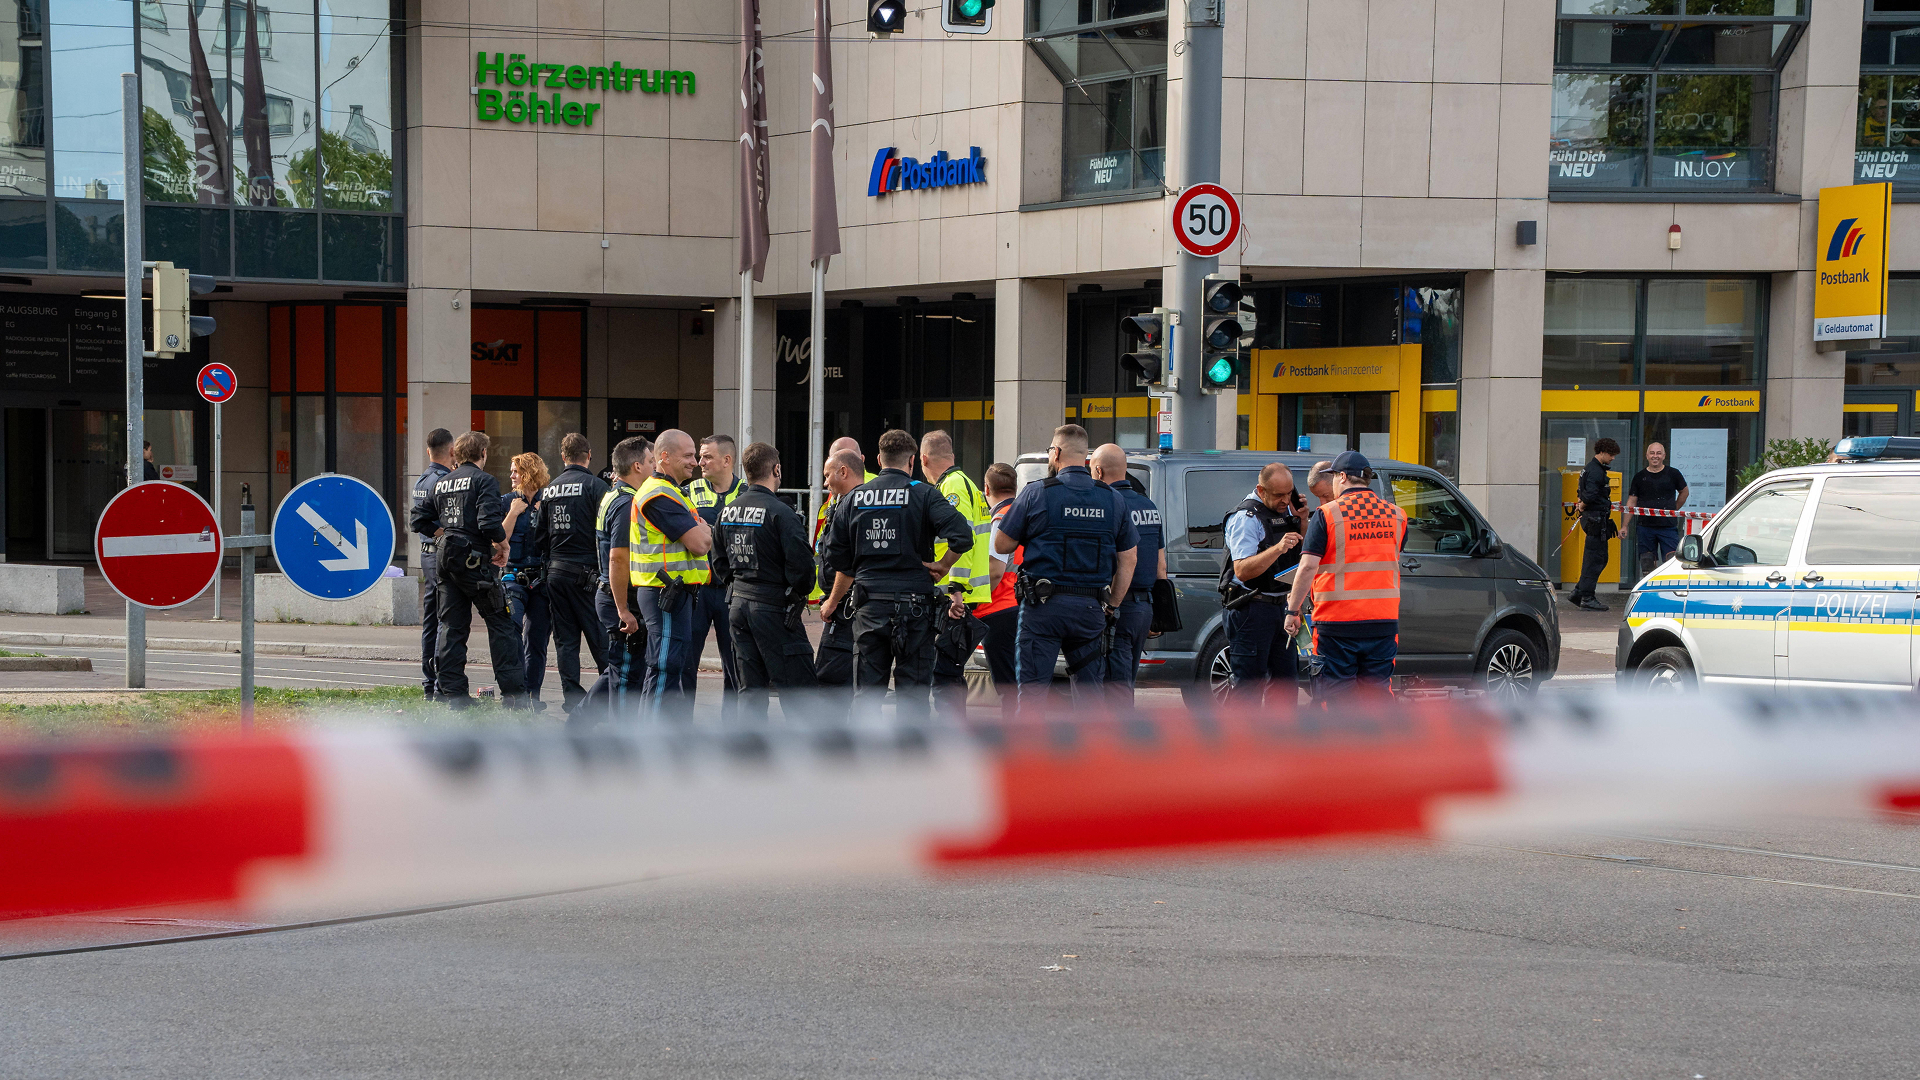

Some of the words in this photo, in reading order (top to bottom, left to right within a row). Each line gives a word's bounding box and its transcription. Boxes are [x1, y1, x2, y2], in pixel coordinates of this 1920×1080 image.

[478, 51, 695, 94] Hörzentrum
[478, 88, 600, 126] Böhler
[1090, 158, 1104, 169] Fühl
[1104, 156, 1117, 167] Dich
[1579, 151, 1606, 162] Dich
[1880, 151, 1909, 162] Dich
[902, 146, 987, 190] Postbank
[1559, 163, 1596, 177] NEU
[1674, 161, 1736, 177] INJOY
[1860, 164, 1899, 178] NEU
[0, 175, 17, 187] EU
[1094, 169, 1113, 184] NEU
[354, 182, 378, 191] Dich
[243, 185, 302, 201] INJOY
[339, 191, 368, 203] NEU
[1189, 204, 1226, 236] 50
[1821, 268, 1870, 285] Postbank
[7, 306, 58, 316] AUGSBURG
[75, 309, 109, 319] Eingang
[112, 310, 118, 318] B
[1824, 323, 1874, 334] Geldautomat
[823, 367, 844, 377] OTEL
[1290, 364, 1329, 376] Postbank
[1331, 365, 1383, 375] Finanzcenter
[1094, 404, 1112, 412] Postbank
[1715, 398, 1755, 406] Postbank
[435, 477, 472, 494] POLIZEI
[542, 483, 583, 500] POLIZEI
[413, 489, 427, 497] POLIZEI
[854, 488, 909, 507] POLIZEI
[447, 498, 457, 507] BY
[555, 505, 567, 513] BY
[721, 506, 766, 524] POLIZEI
[1064, 507, 1104, 518] POLIZEI
[553, 514, 571, 522] 5410
[872, 518, 888, 529] BY
[1131, 510, 1162, 526] OLIZEI
[1350, 521, 1393, 530] NOTFALL
[734, 534, 747, 544] BY
[866, 529, 880, 540] SWN
[881, 529, 896, 540] 7103
[1350, 531, 1394, 541] MANAGER
[1814, 593, 1889, 618] POLIZEI
